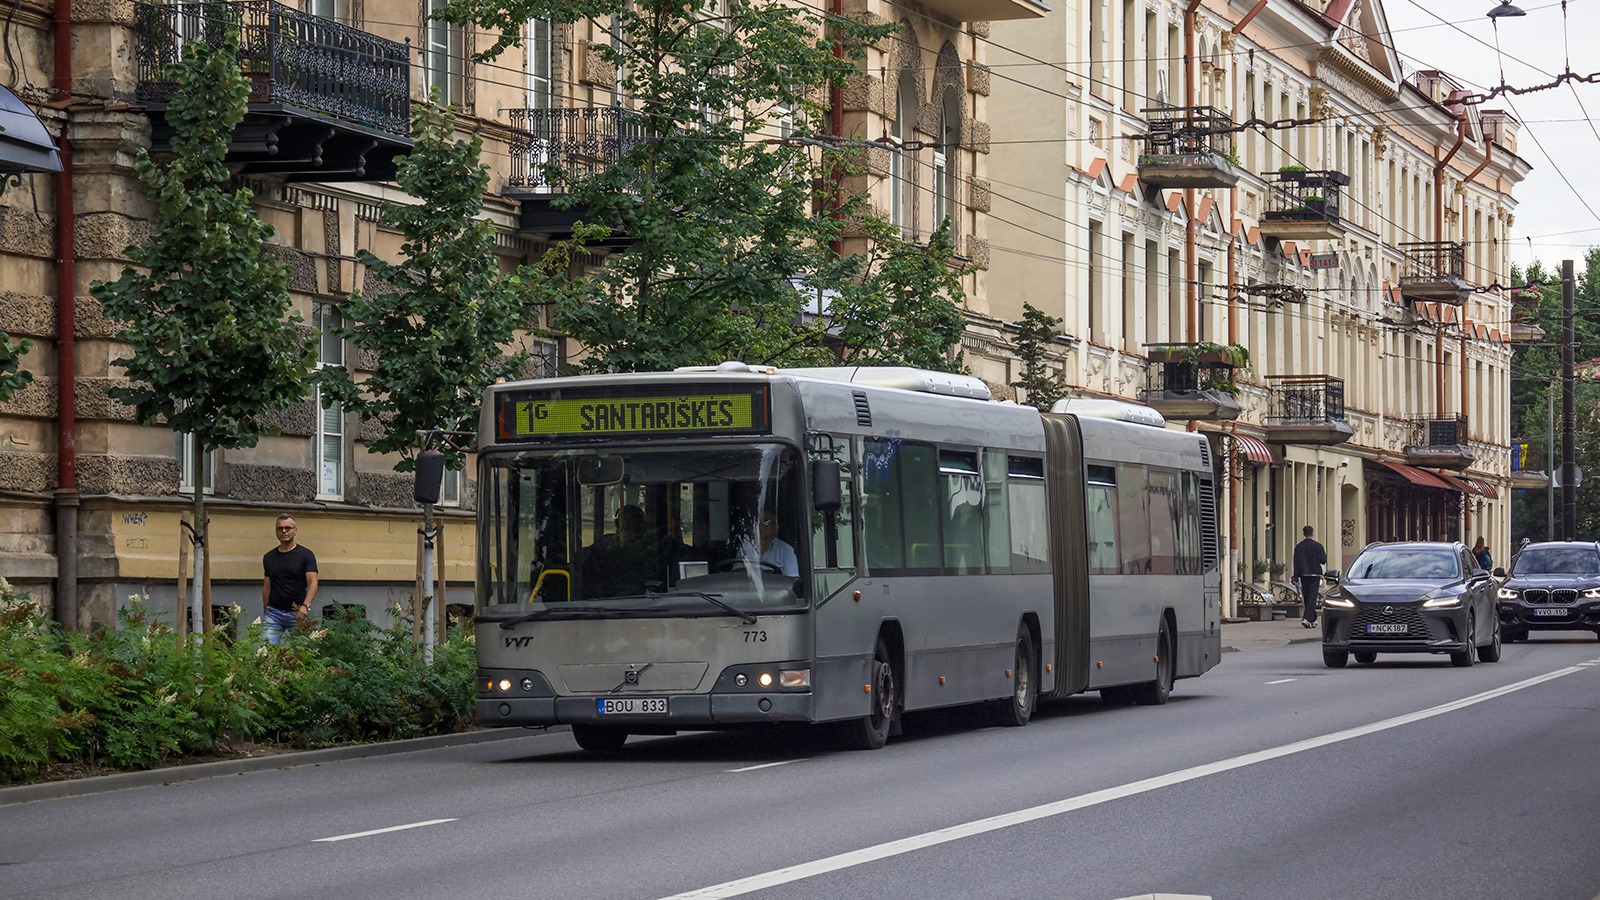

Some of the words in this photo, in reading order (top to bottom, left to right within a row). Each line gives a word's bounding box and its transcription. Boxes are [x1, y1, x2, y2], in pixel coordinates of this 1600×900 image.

[580, 396, 733, 431] SANTARIŠKĖS
[1376, 624, 1406, 632] NCK187
[505, 636, 534, 648] VVT
[743, 631, 767, 642] 773
[606, 700, 633, 713] BOU
[641, 700, 665, 712] 833
